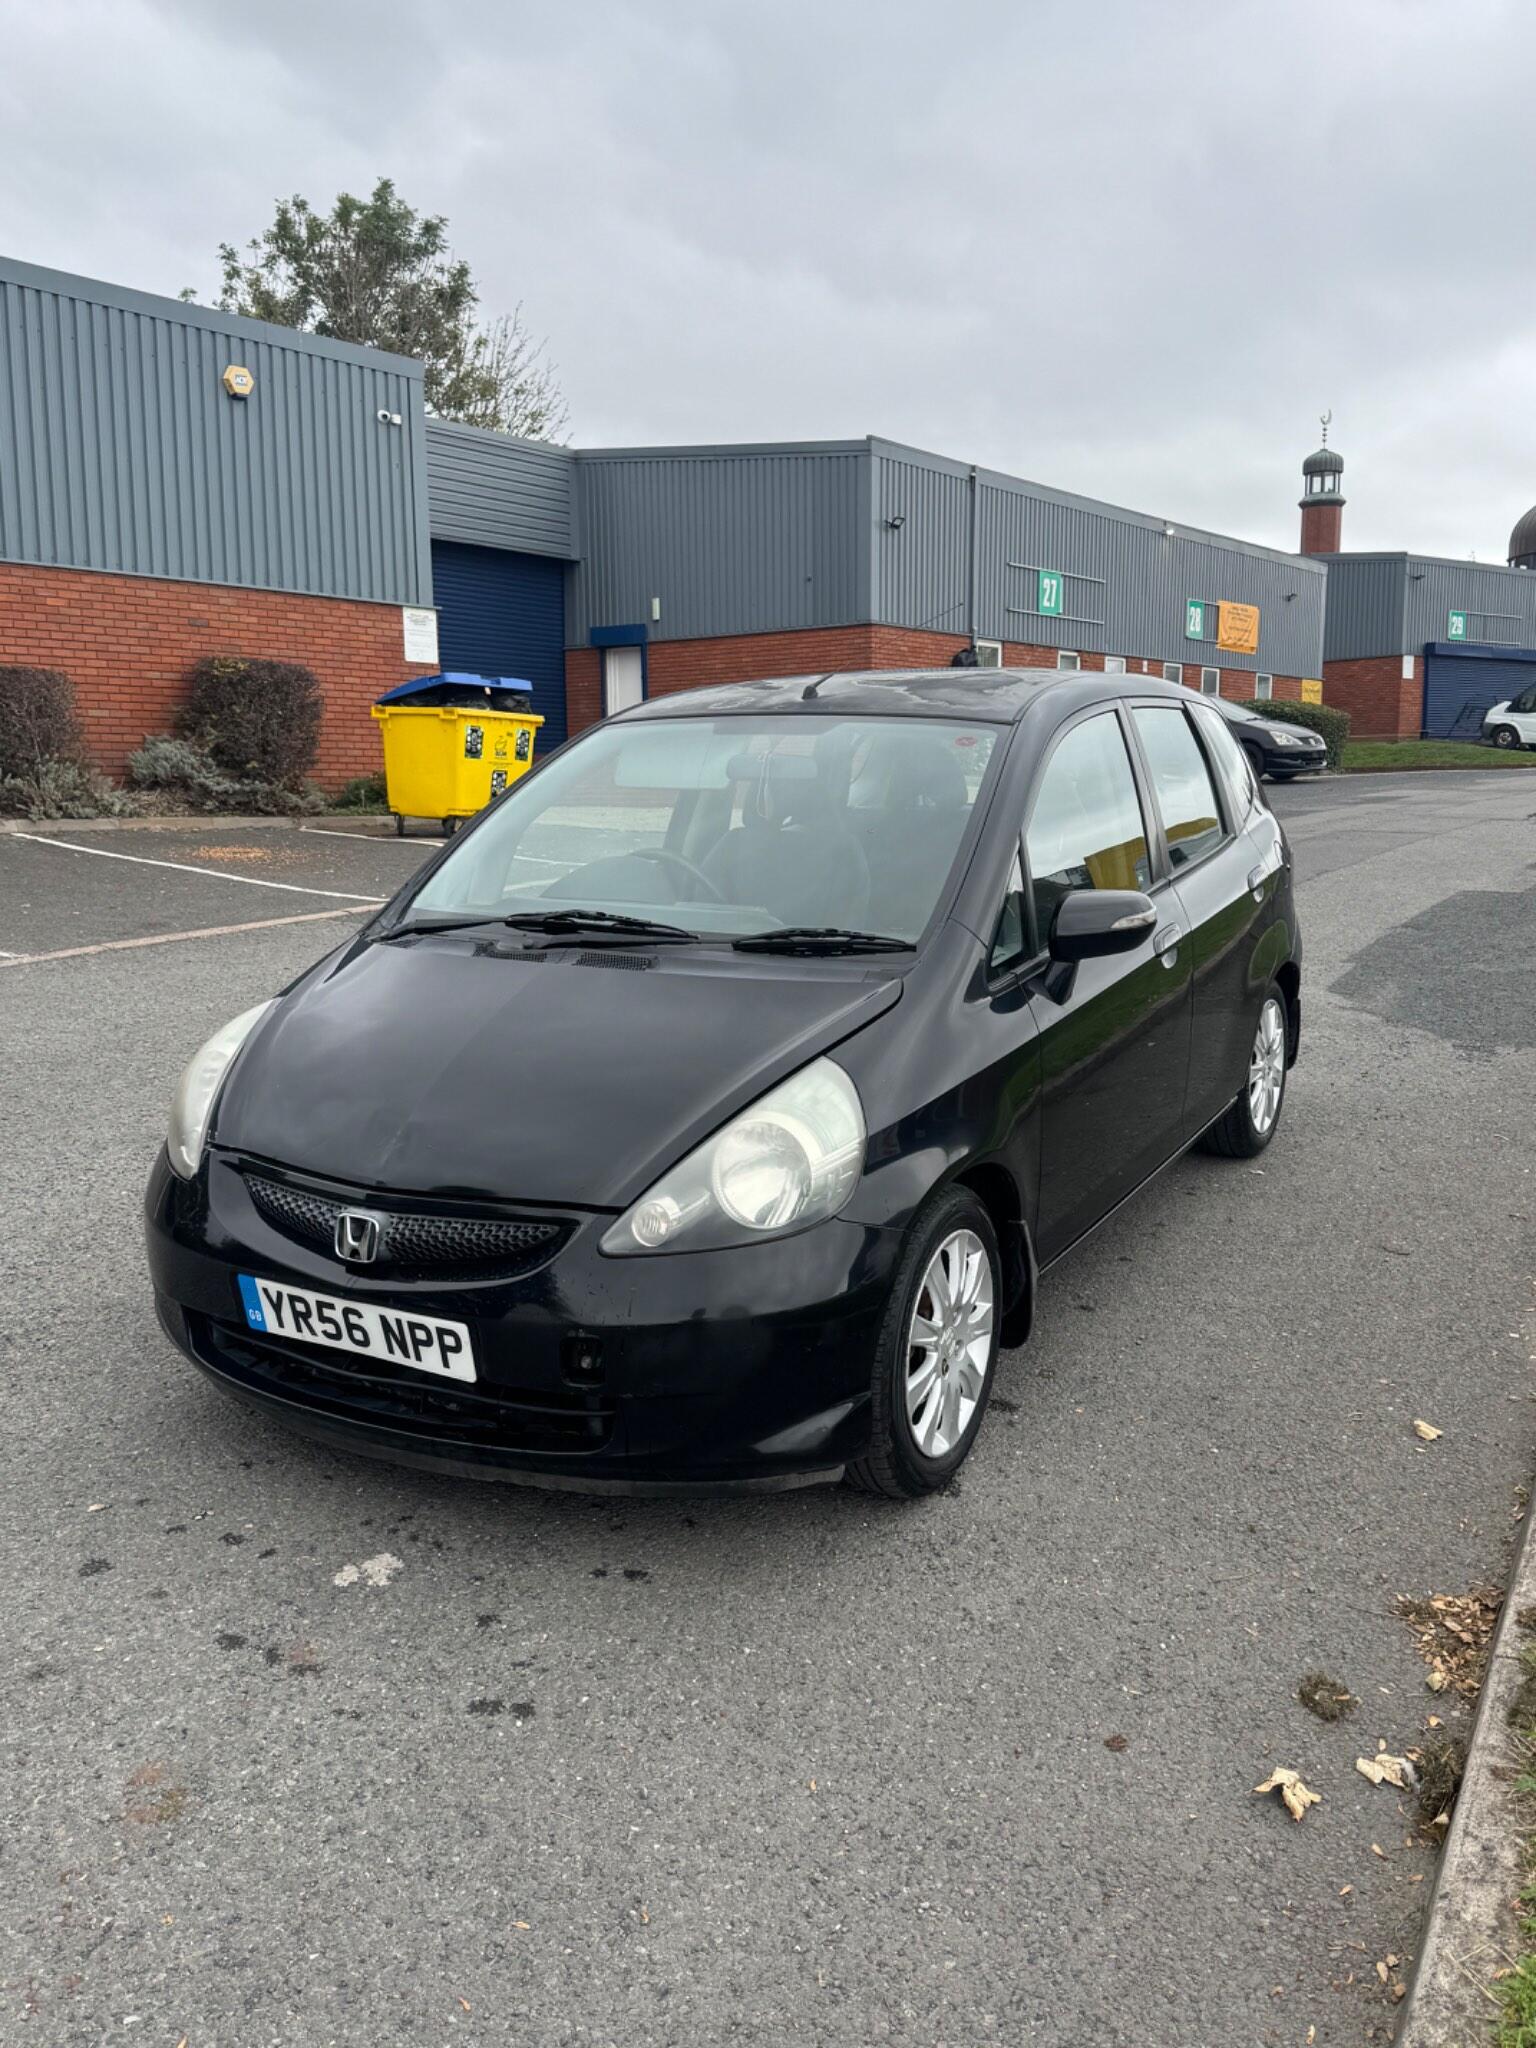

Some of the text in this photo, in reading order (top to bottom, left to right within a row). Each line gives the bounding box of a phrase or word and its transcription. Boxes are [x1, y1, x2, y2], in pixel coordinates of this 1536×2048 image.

[1043, 578, 1057, 607] 27
[1190, 607, 1201, 632] 28
[249, 1308, 262, 1321] GB
[262, 1287, 463, 1369] YR56 NPP
